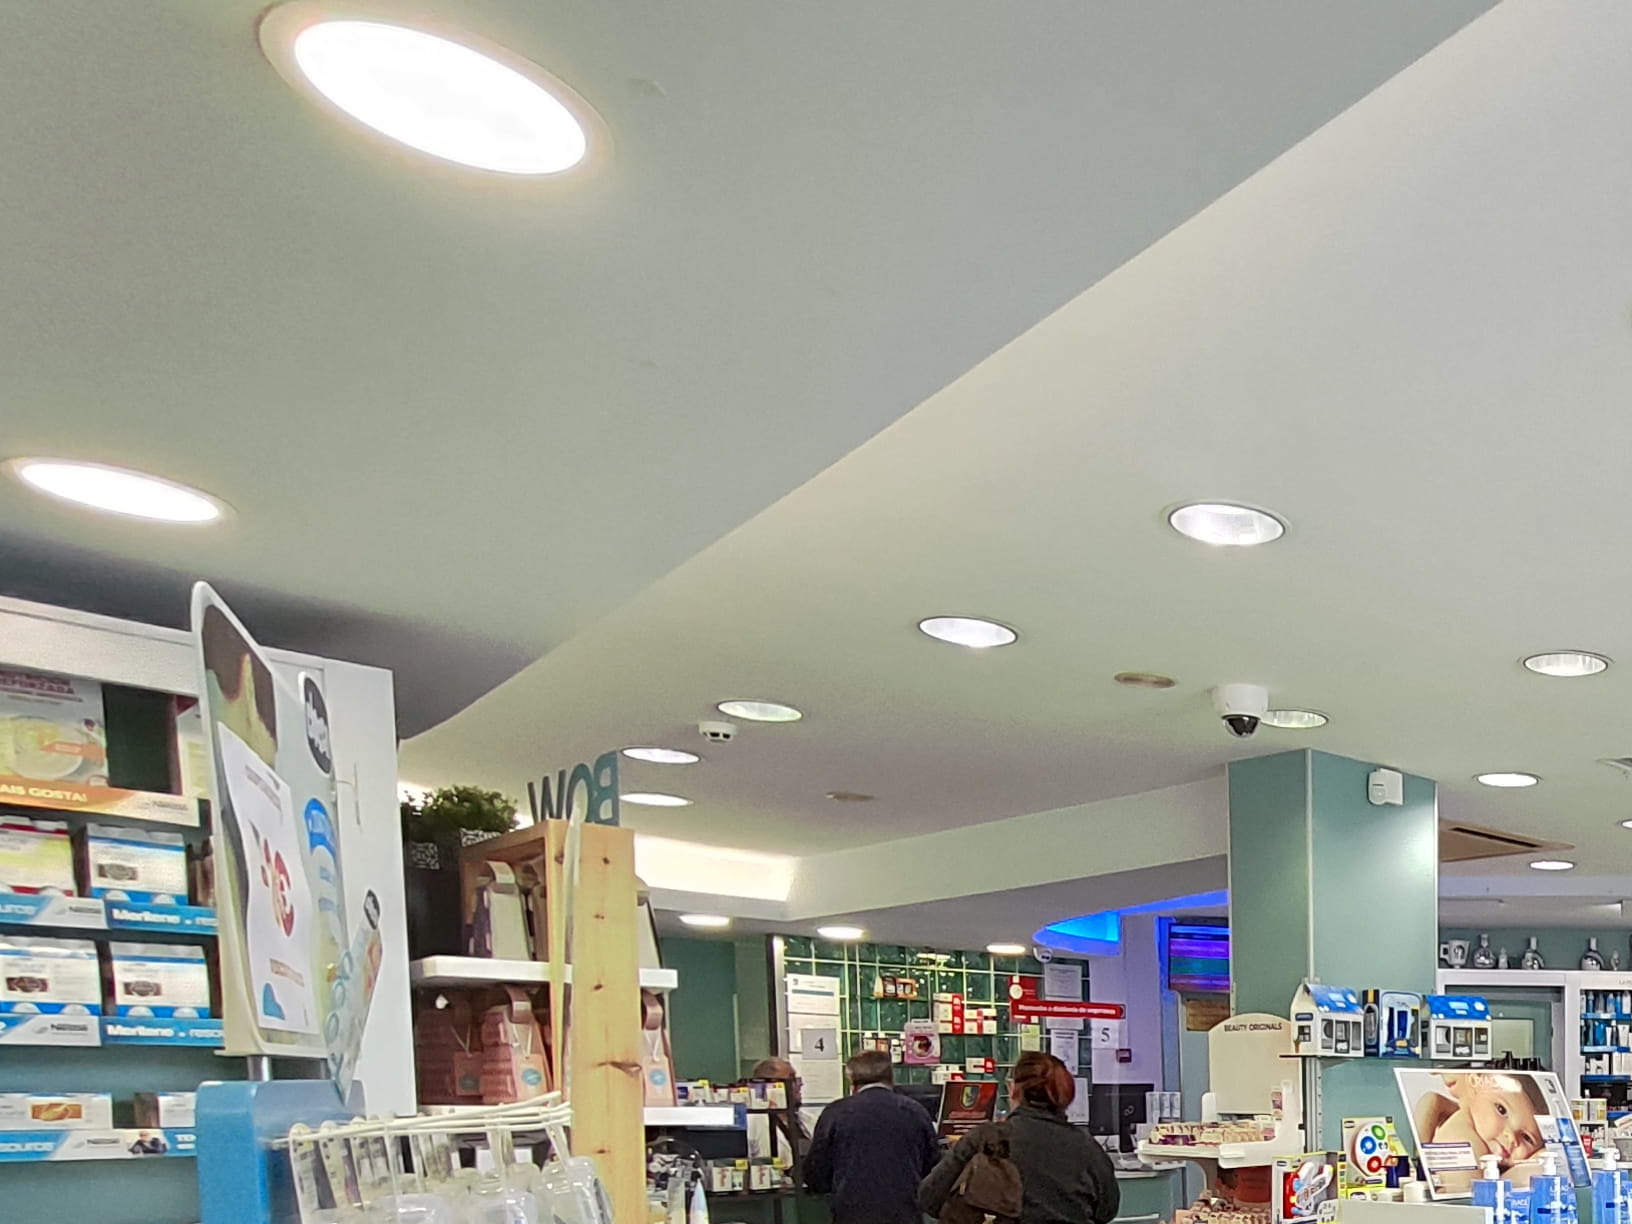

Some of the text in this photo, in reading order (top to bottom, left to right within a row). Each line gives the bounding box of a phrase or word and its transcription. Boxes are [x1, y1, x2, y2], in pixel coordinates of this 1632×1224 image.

[1101, 1027, 1111, 1042] 5
[1224, 1022, 1282, 1032] BEAUTY ORIGINALS
[814, 1037, 825, 1052] 4
